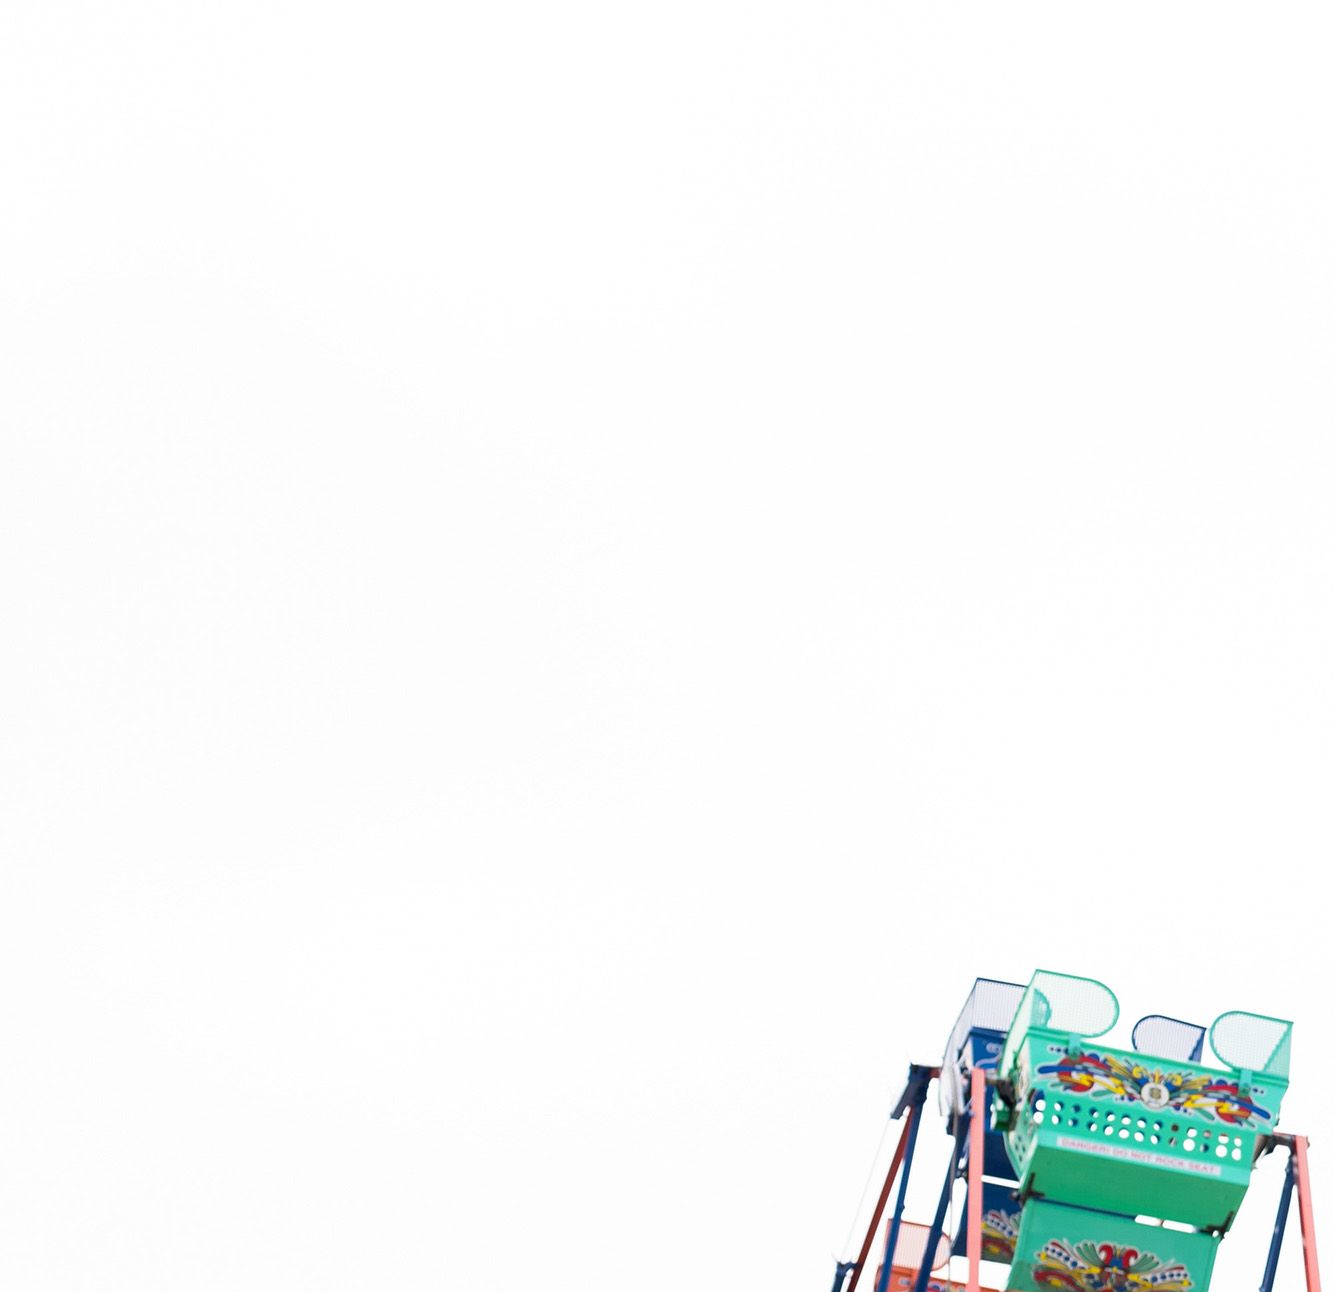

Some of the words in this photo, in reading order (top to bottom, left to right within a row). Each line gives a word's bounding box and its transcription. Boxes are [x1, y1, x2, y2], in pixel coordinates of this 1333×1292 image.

[1111, 1146, 1128, 1157] DO
[1130, 1150, 1152, 1162] NOT
[1155, 1156, 1185, 1168] ROCK
[1188, 1162, 1215, 1174] SEAT
